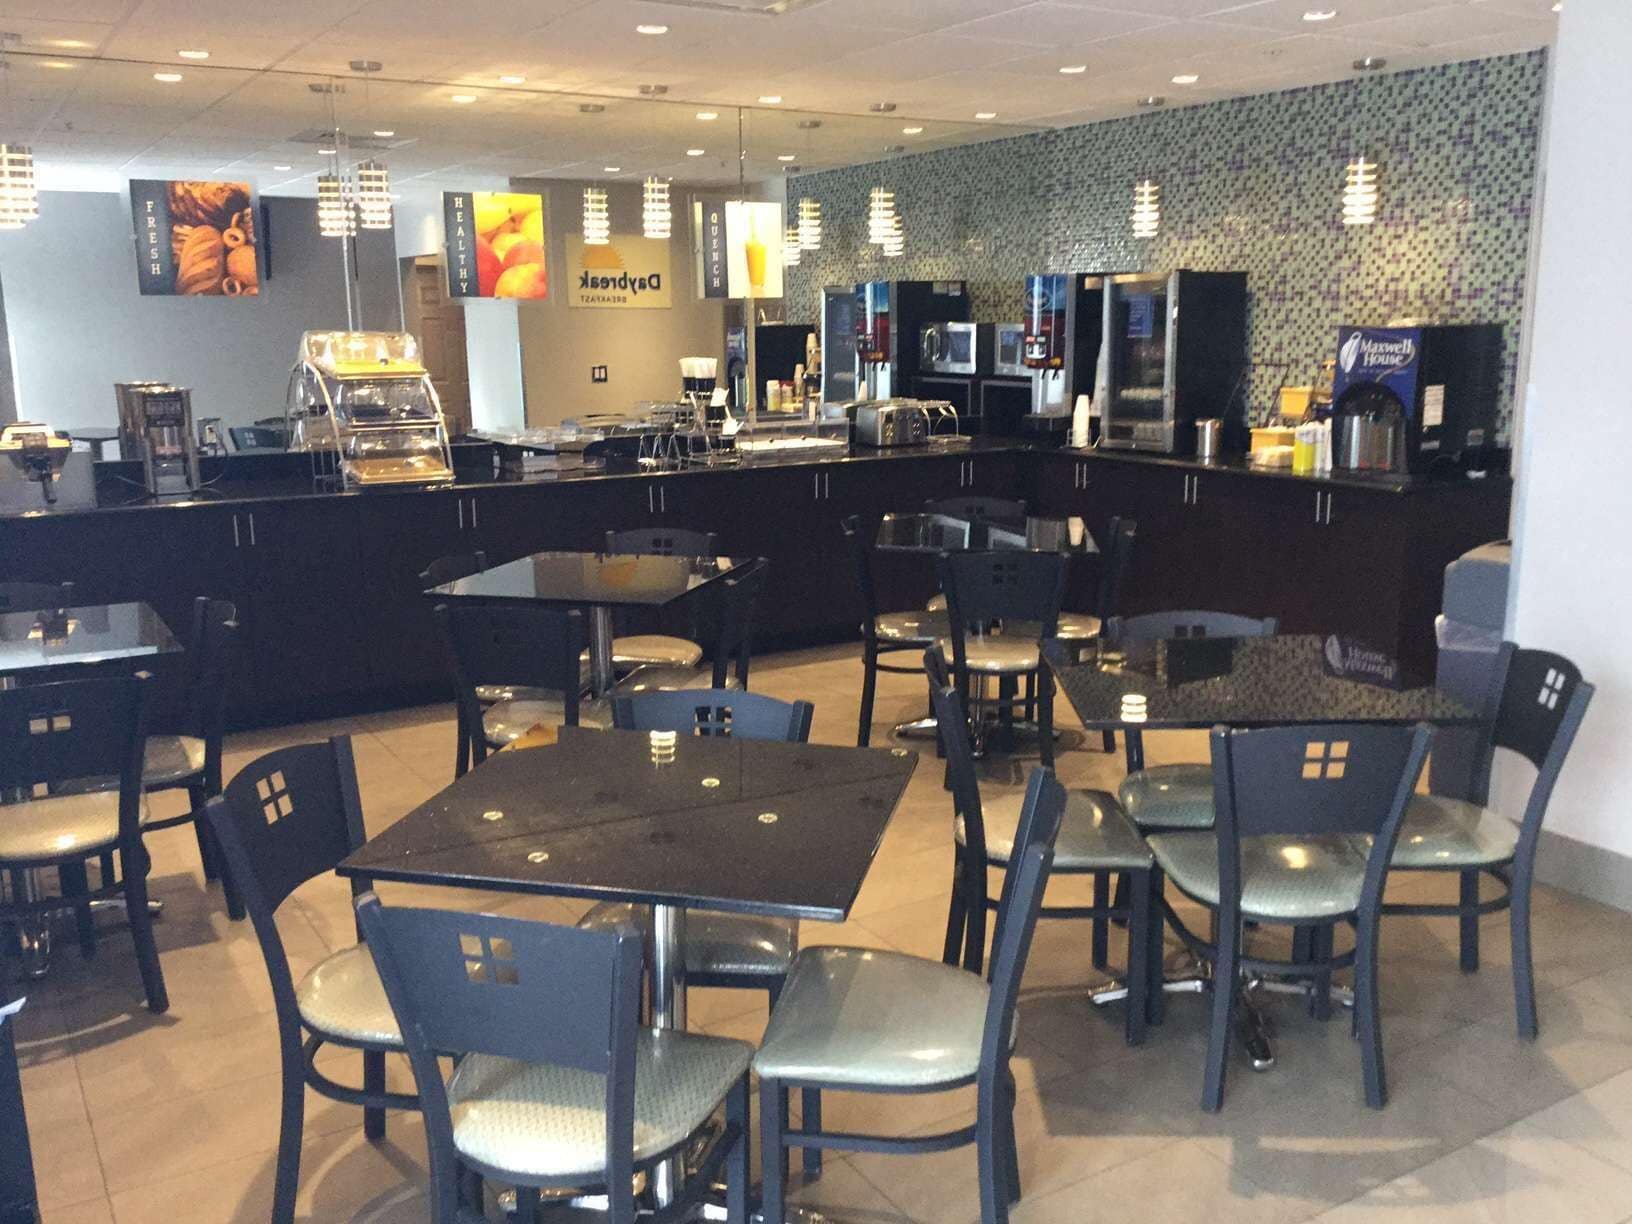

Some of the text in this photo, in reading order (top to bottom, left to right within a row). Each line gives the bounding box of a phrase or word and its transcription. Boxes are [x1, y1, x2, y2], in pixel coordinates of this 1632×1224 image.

[146, 201, 161, 276] FRESH
[454, 197, 469, 293] HEALTHY
[710, 212, 721, 288] QUENCH
[1360, 338, 1413, 354] Maxwell
[1363, 352, 1404, 367] House
